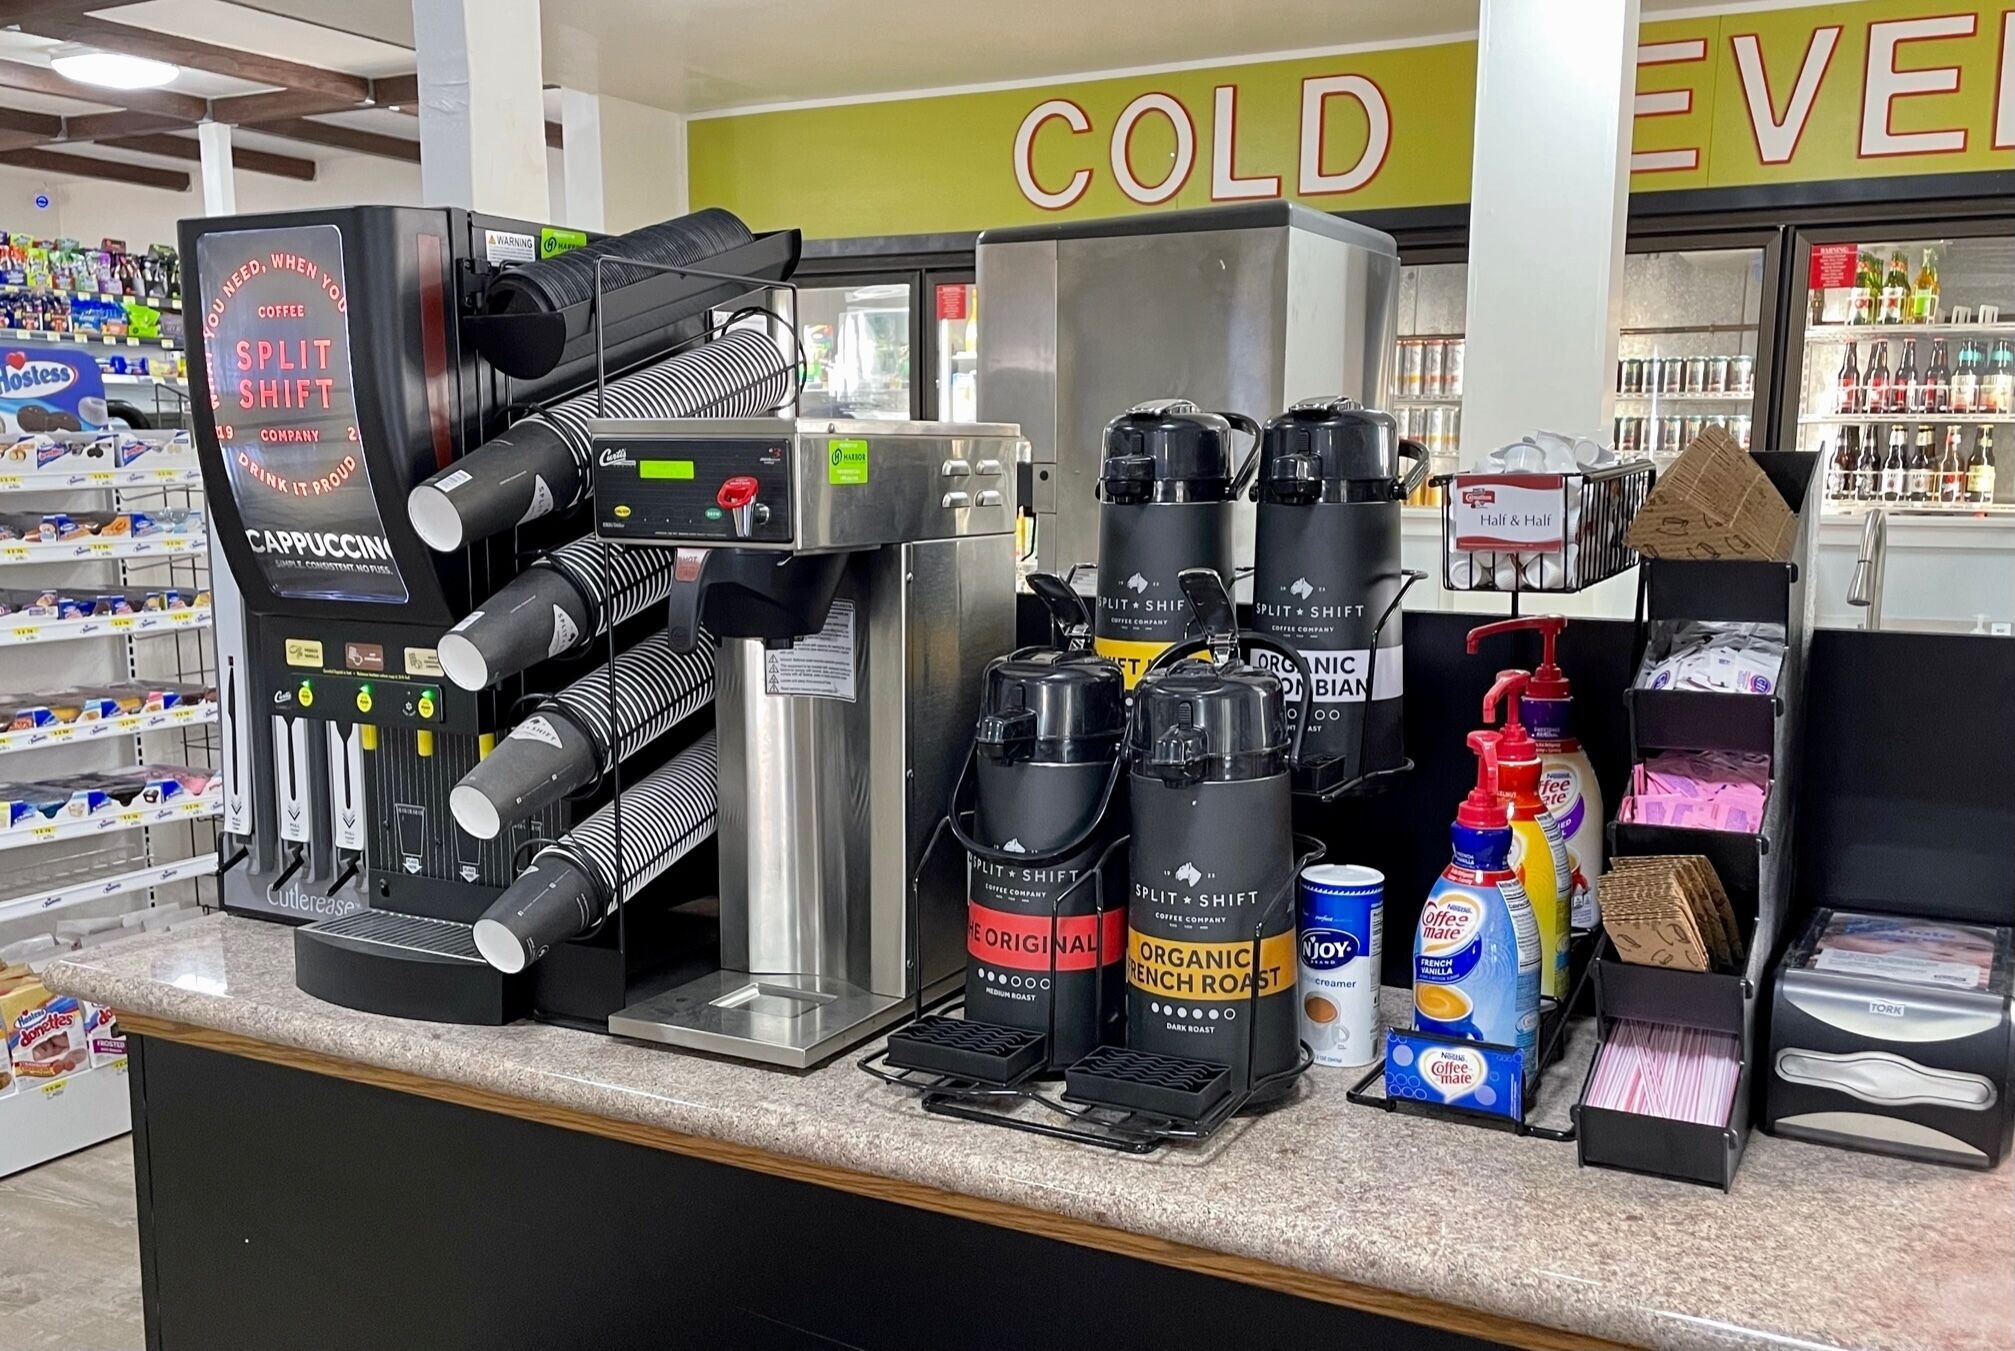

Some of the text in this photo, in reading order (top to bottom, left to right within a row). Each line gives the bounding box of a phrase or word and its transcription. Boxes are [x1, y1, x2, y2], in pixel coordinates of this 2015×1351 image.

[1013, 73, 1392, 212] COLD
[497, 234, 532, 249] WARNING
[203, 253, 347, 340] YOU NEED, WHEN YOU
[258, 304, 305, 318] COFFEE
[236, 339, 331, 371] SPLIT
[239, 379, 333, 409] SHIFT
[260, 429, 320, 442] COMPANY
[599, 448, 628, 467] Curtis
[238, 452, 356, 497] DRINK IT PROUD
[1480, 514, 1552, 527] Half & Half
[370, 565, 394, 576] FUSS.
[1098, 595, 1185, 611] SPLIT SHIF
[1256, 602, 1364, 618] SPLIT SHIFT
[1111, 617, 1132, 625] COFFEE
[972, 855, 1079, 883] SPLIT SHIFT
[985, 883, 1046, 898] COFFEE COMPANY
[1135, 883, 1258, 908] SPLIT SHIFT
[266, 882, 355, 916] Cutlerease
[1155, 912, 1183, 922] COFFEE
[1422, 901, 1469, 927] Coffee
[968, 919, 1097, 954] HE ORIGINAL
[1423, 926, 1461, 940] mate
[1140, 941, 1251, 970] ORGANIC
[1421, 959, 1453, 967] FRENCH
[1421, 966, 1453, 975] VANILLA
[1201, 966, 1281, 994] ROAST
[1315, 977, 1357, 989] creamer
[986, 987, 1036, 1001] MEDIUM ROAST
[1871, 1003, 1902, 1015] TORK
[20, 1013, 73, 1047] donettes
[1166, 1022, 1215, 1033] DARK ROAST
[1441, 1074, 1472, 1085] mate
